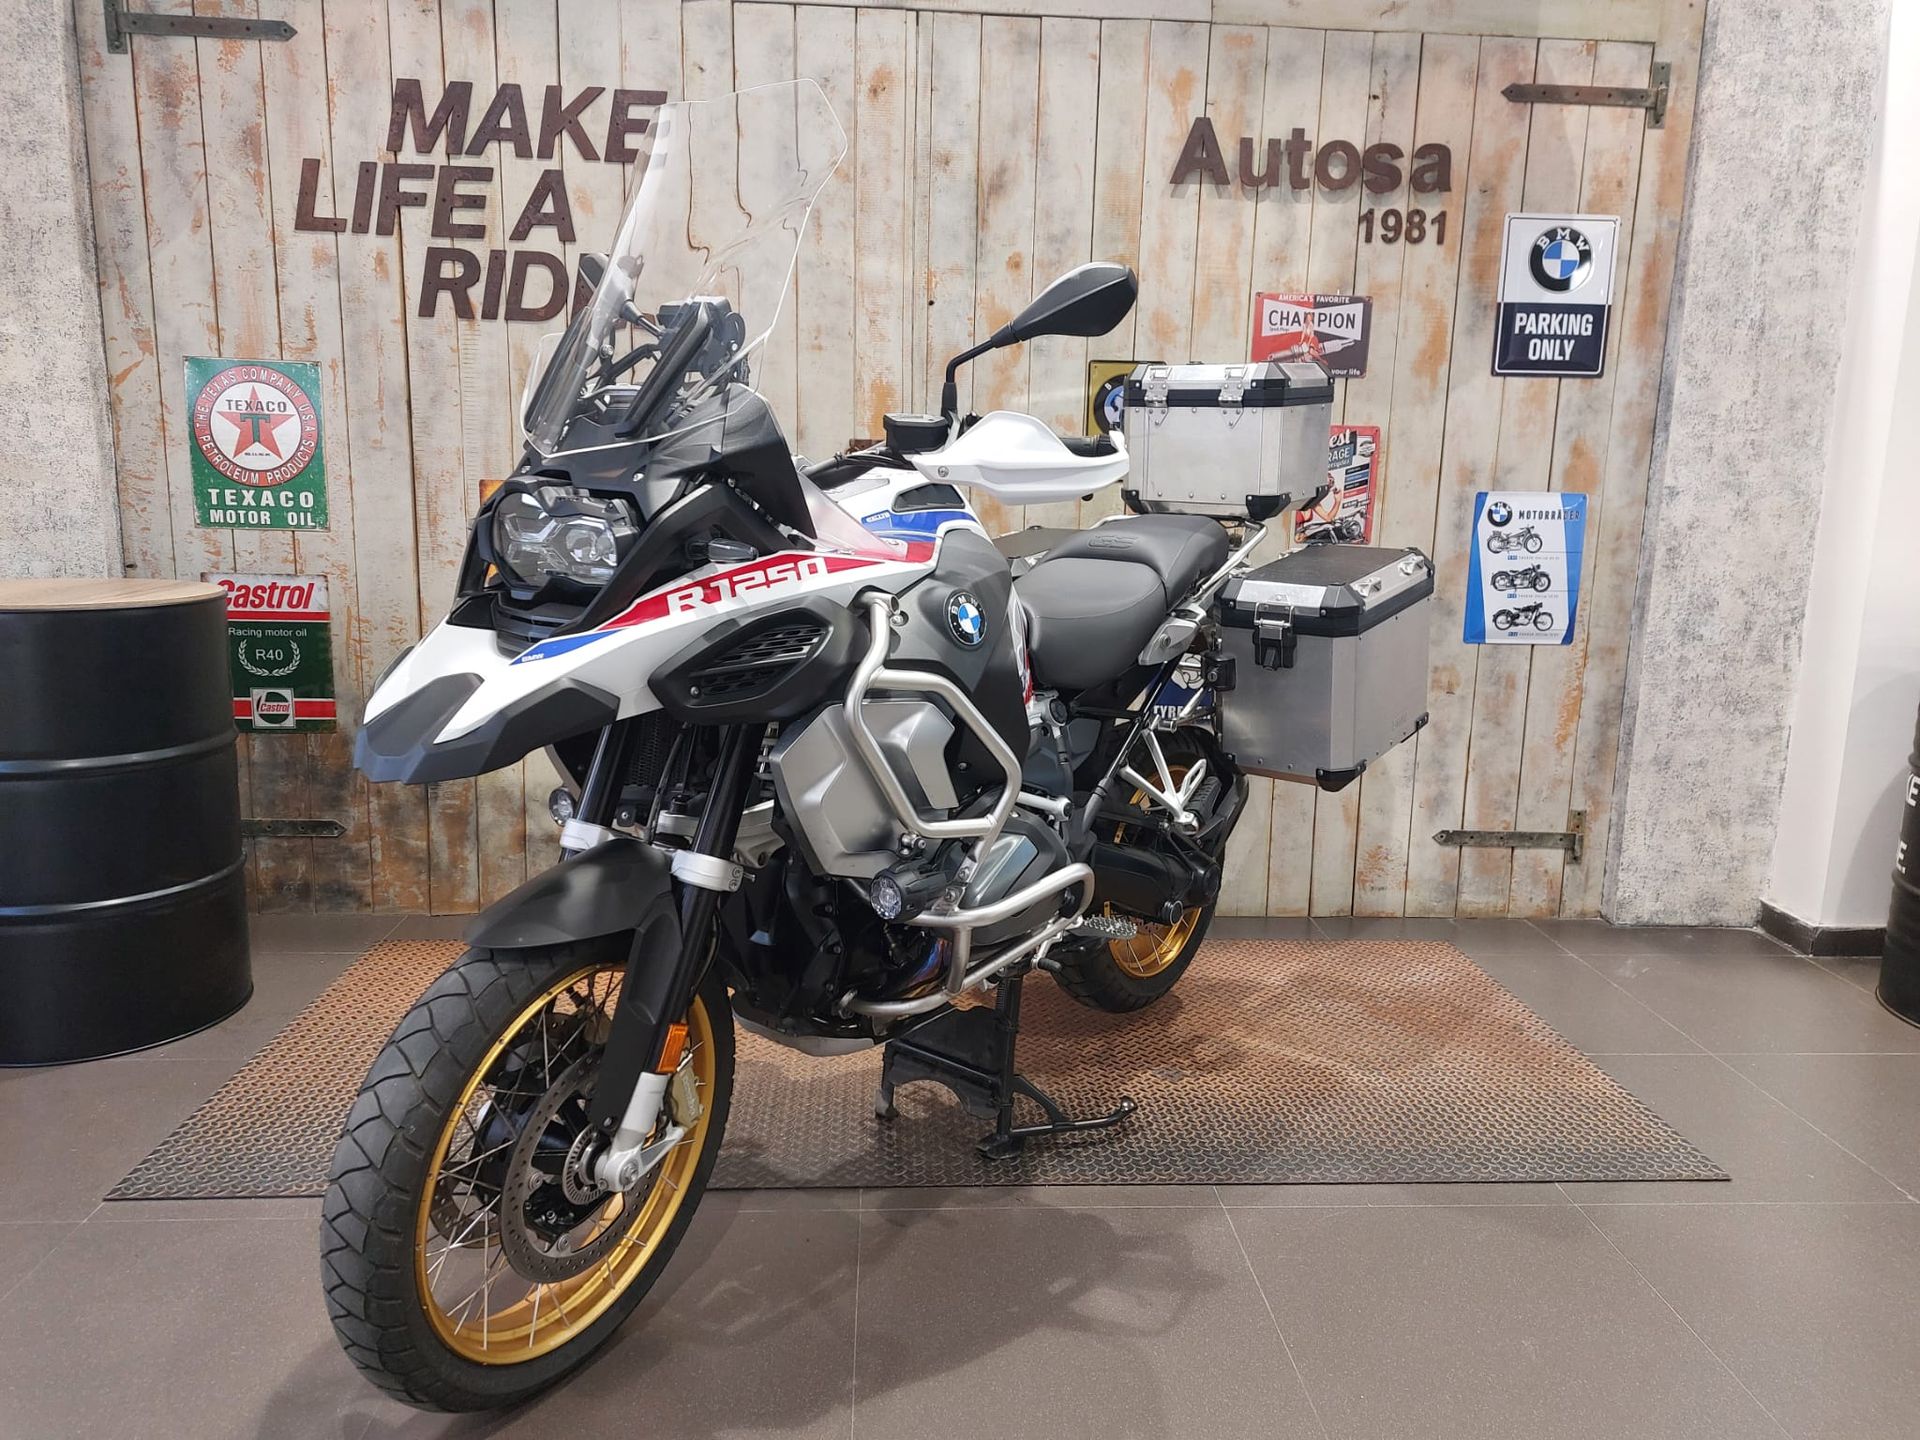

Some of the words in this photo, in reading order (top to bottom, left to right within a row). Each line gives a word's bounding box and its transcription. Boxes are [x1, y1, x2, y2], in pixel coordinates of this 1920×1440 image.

[386, 79, 668, 163] MAKE
[1169, 117, 1452, 194] Autosa
[295, 158, 494, 238] LIFE
[509, 169, 577, 242] A
[1359, 208, 1447, 245] 1981
[1536, 228, 1590, 250] BMW
[1279, 294, 1314, 302] AMERICA'S
[1316, 295, 1350, 303] FAVORITE
[1514, 313, 1594, 336] PARKING
[1528, 338, 1575, 361] ONLY
[202, 371, 238, 402] TEXAS
[242, 368, 302, 399] COMPANY
[196, 405, 209, 429] THE
[226, 399, 287, 413] TEXACO
[1328, 429, 1351, 448] est
[199, 436, 260, 484] PETROLEUM
[267, 440, 315, 484] PRODUCTS
[208, 488, 315, 508] TEXACO
[209, 509, 271, 525] MOTOR
[287, 511, 316, 526] OIL
[217, 579, 315, 609] Castrol
[228, 627, 262, 638] Racing
[265, 628, 293, 637] motor
[295, 628, 307, 637] oil
[255, 649, 284, 660] R40
[259, 702, 291, 713] Castrol
